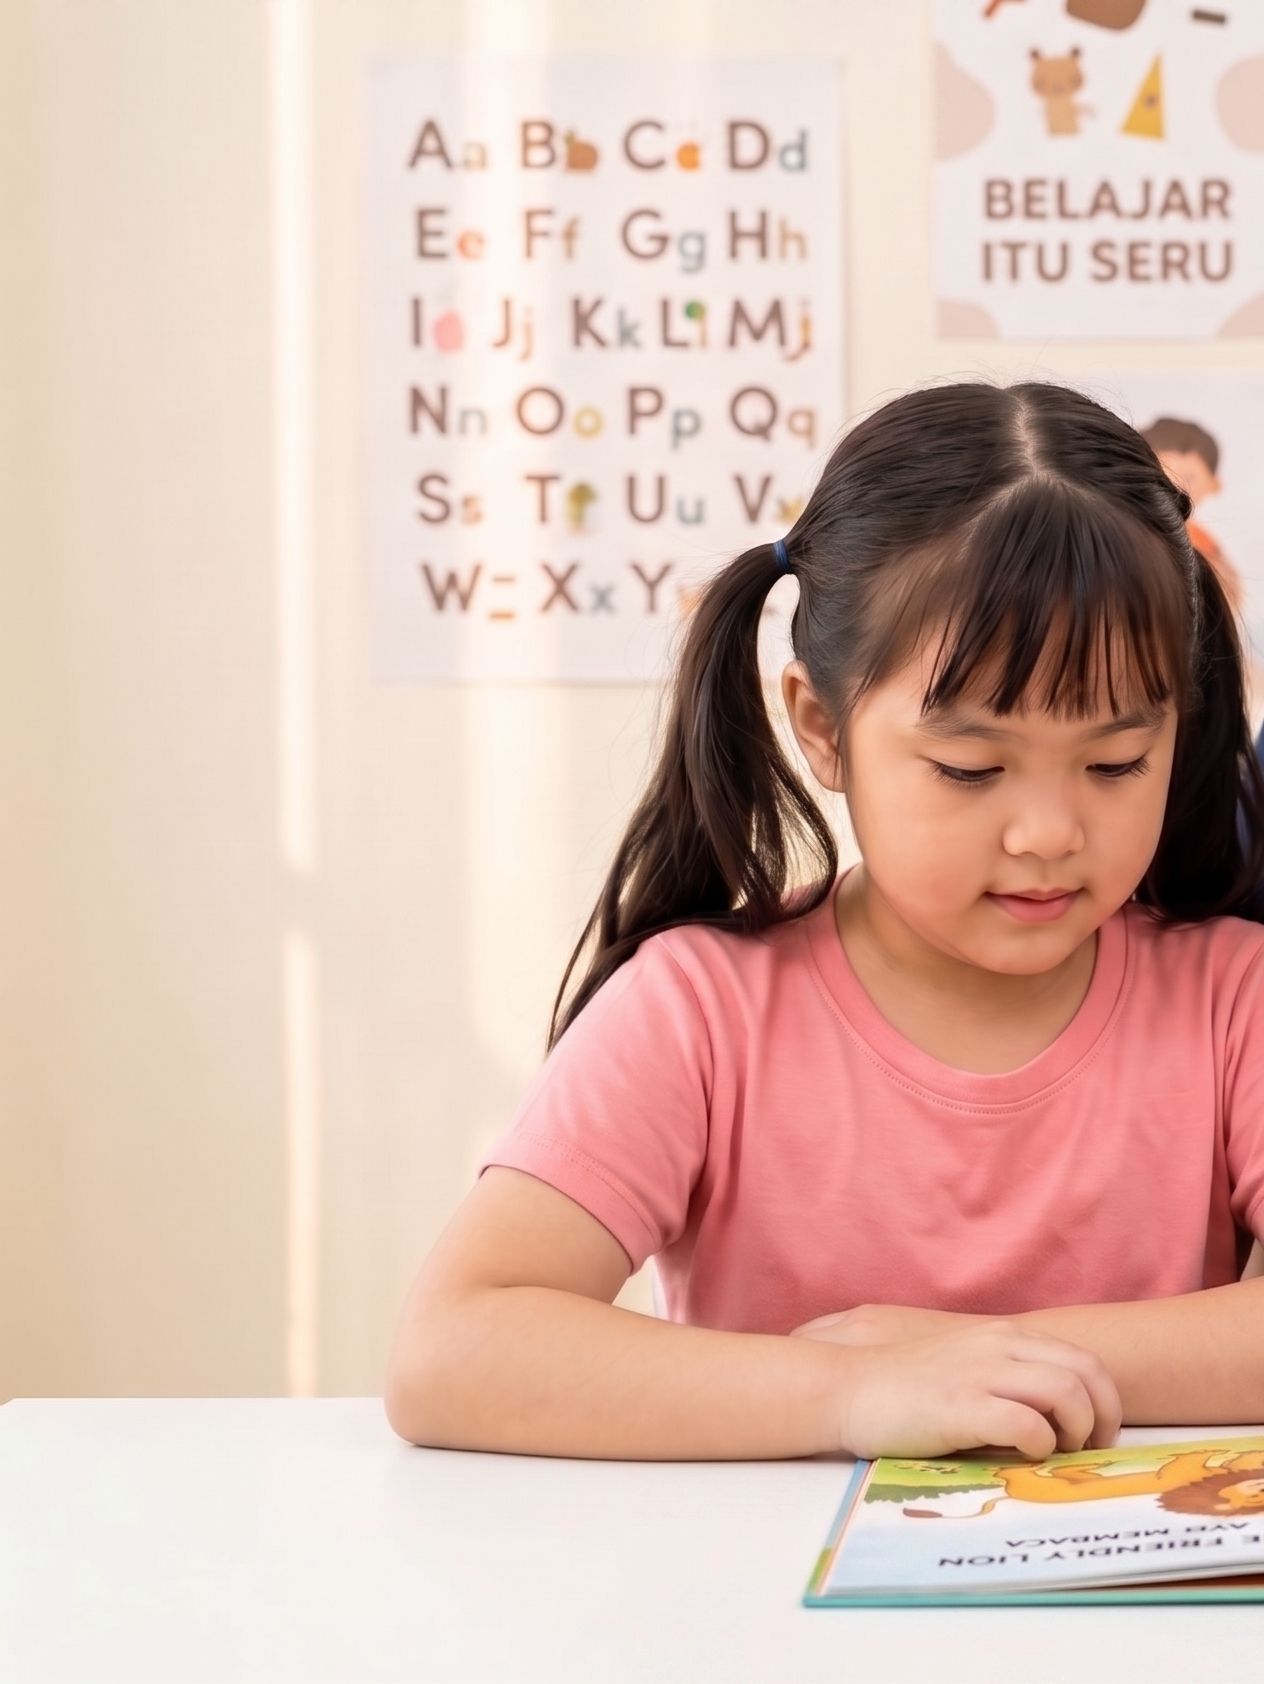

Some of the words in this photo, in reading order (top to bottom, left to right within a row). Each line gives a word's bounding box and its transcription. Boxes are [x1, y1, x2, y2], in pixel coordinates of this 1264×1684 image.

[983, 178, 1232, 220] BELAJAR
[982, 241, 1069, 282] ITU
[1092, 241, 1233, 282] SERU
[1005, 1527, 1170, 1547] MEMBACA
[1044, 1536, 1223, 1560] FRIENDLY
[938, 1553, 1029, 1567] LION
